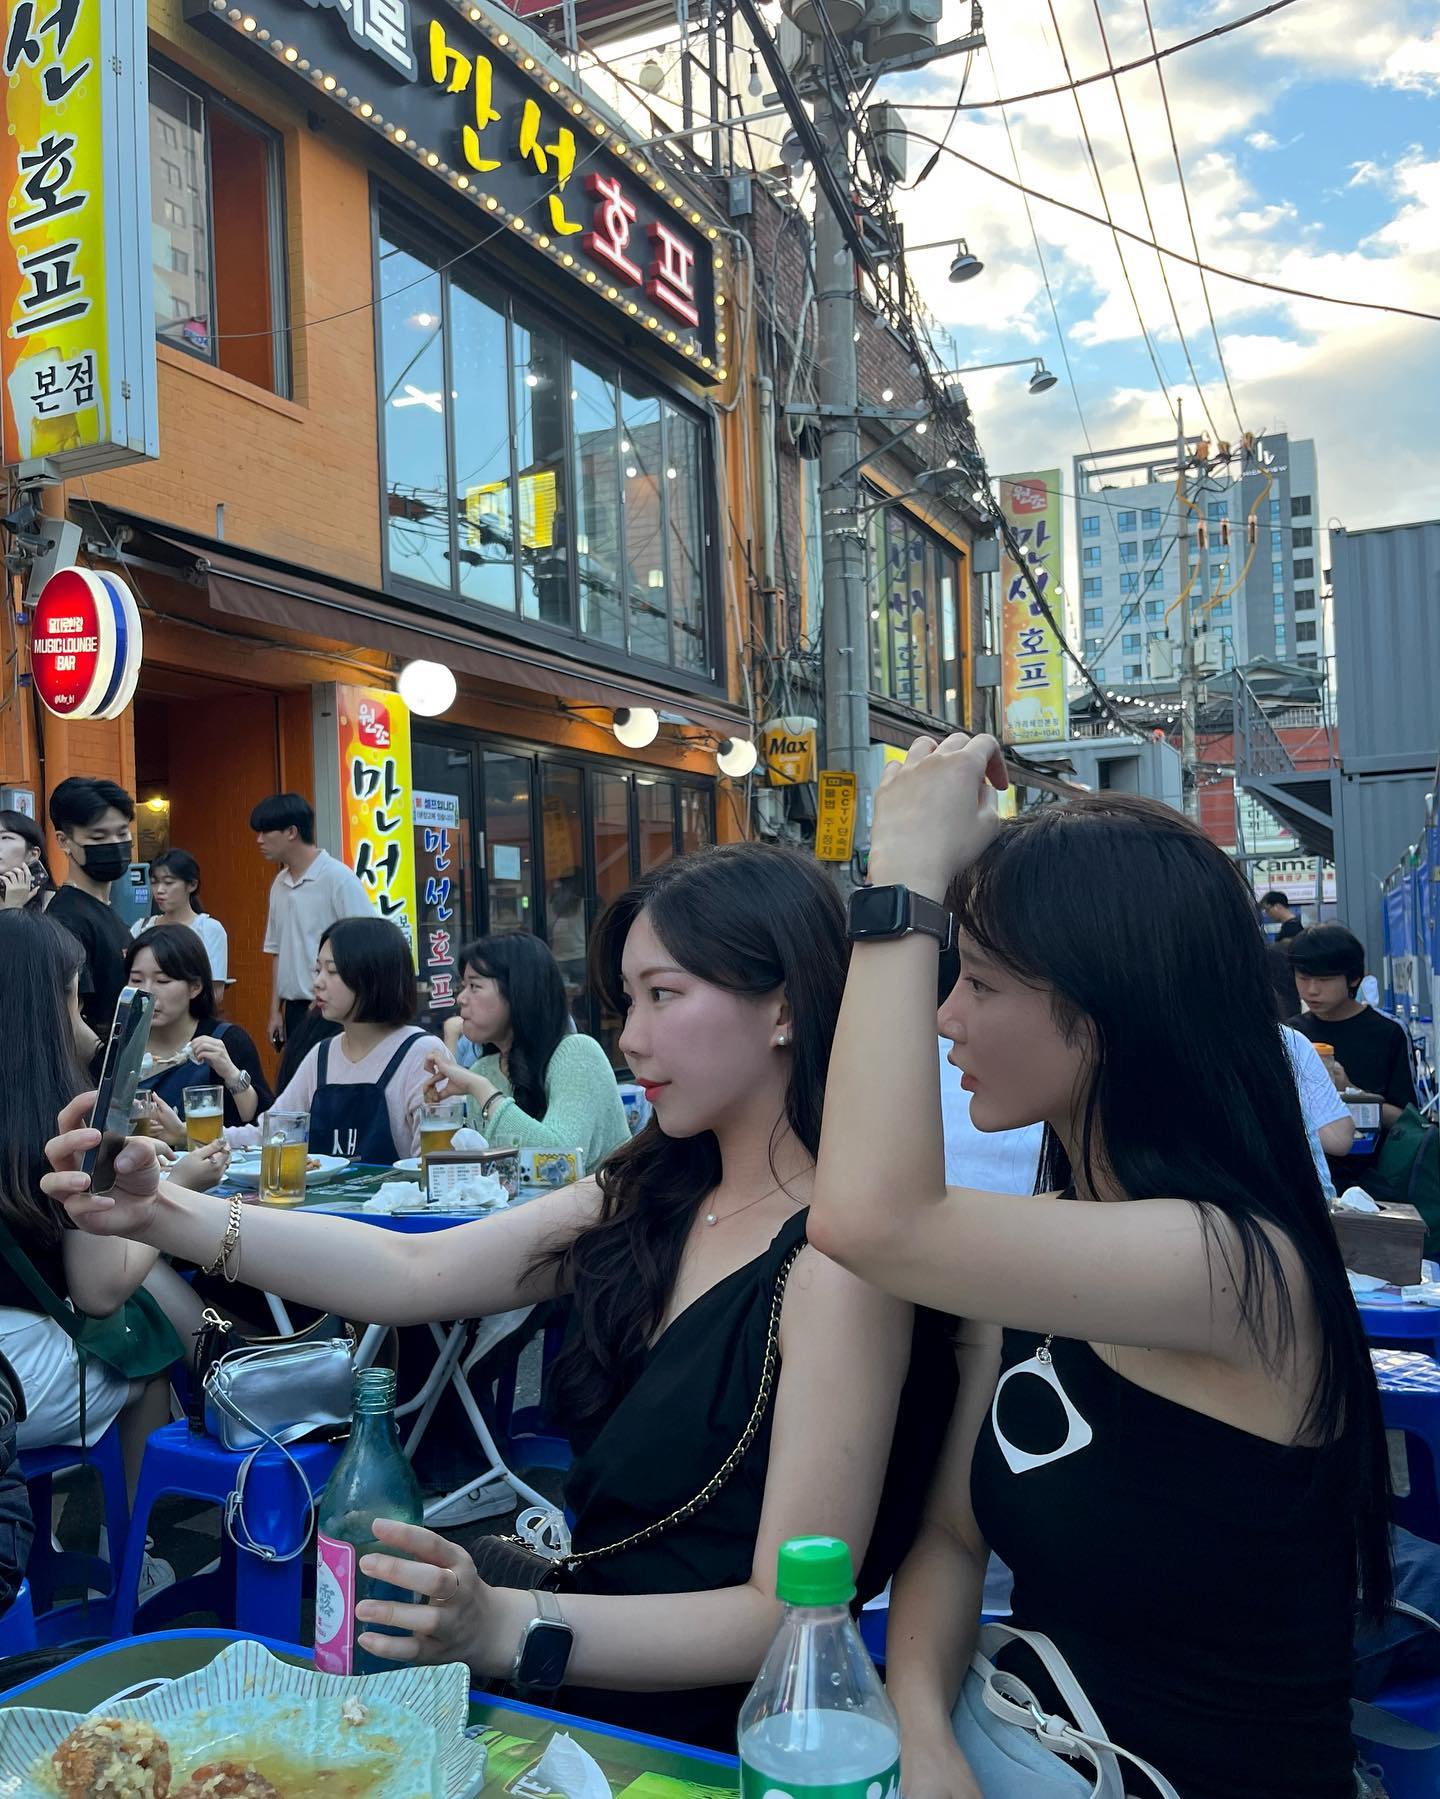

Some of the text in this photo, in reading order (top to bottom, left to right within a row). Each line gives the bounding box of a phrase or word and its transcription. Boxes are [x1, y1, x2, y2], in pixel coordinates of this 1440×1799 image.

[29, 354, 94, 412] 본점
[34, 636, 98, 654] MUSIC LOUNGE
[55, 655, 76, 671] BAR
[358, 703, 391, 746] 원조
[769, 737, 809, 755] Max
[840, 789, 850, 825] CCTV
